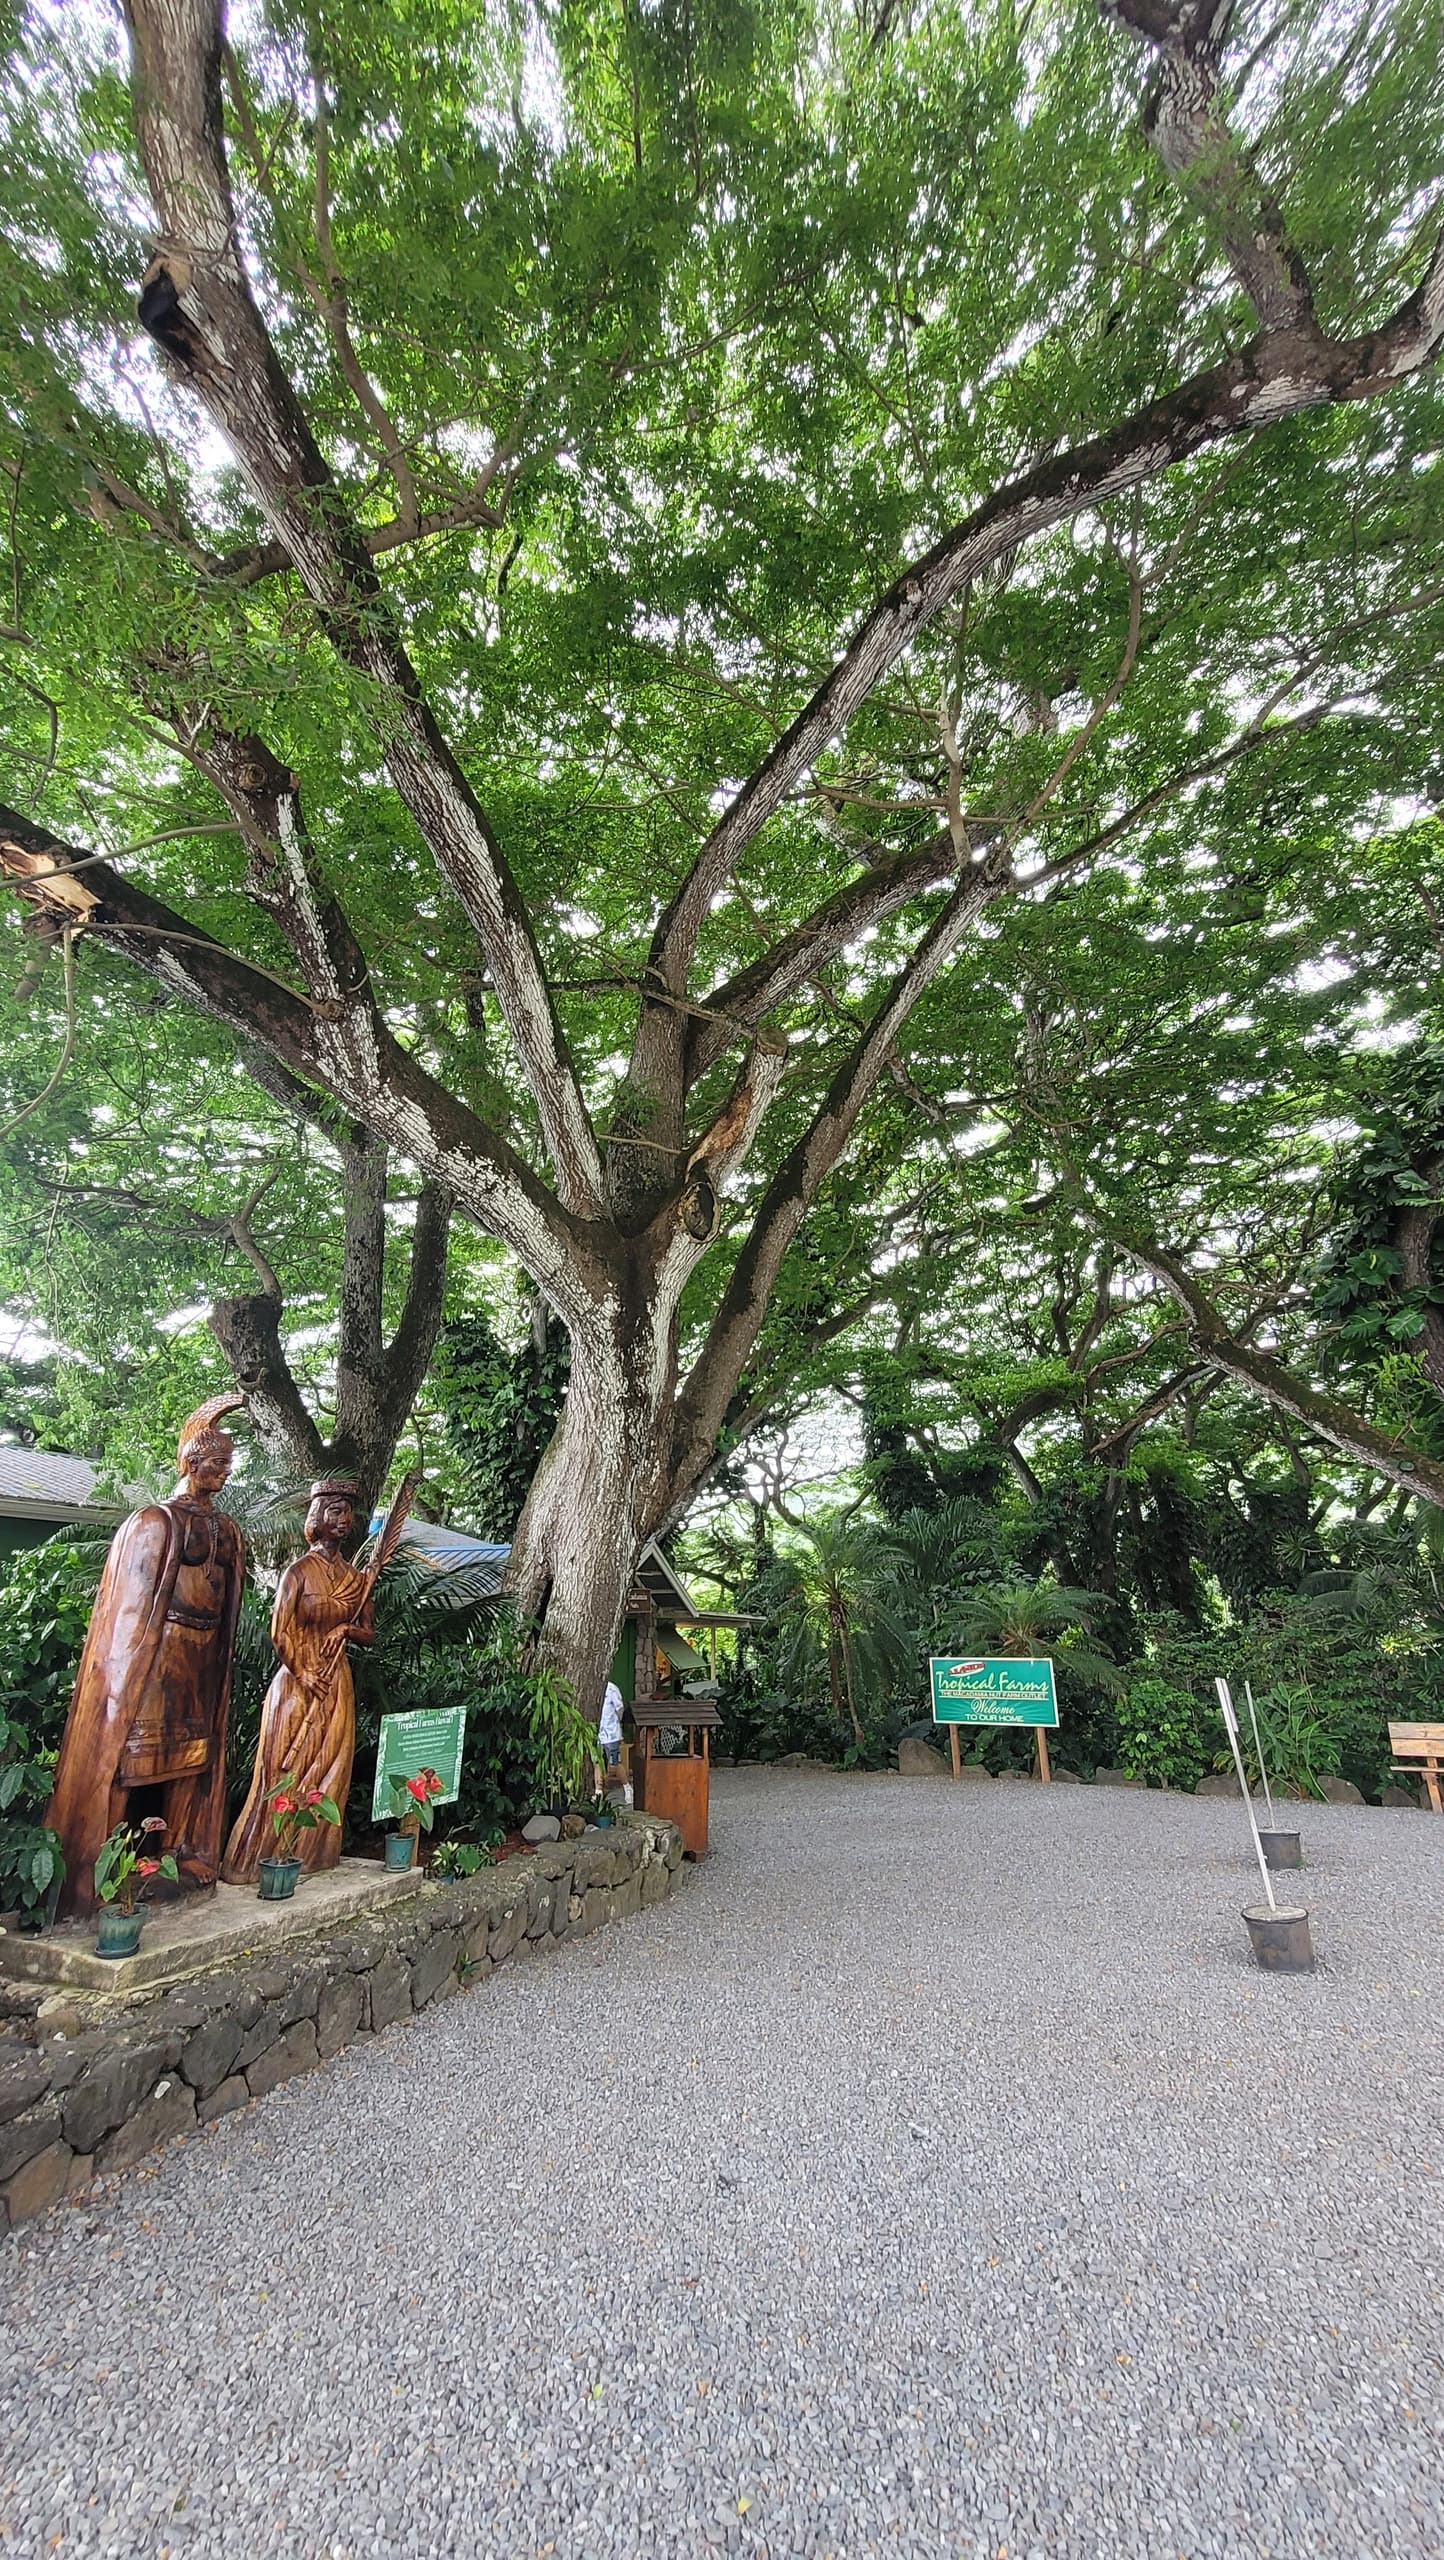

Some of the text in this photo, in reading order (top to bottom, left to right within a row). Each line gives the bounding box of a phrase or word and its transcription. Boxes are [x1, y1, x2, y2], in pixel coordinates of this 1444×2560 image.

[936, 1671, 1049, 1691] Tropical Farms
[971, 1699, 1015, 1714] Welcome
[397, 1719, 419, 1732] Tropical
